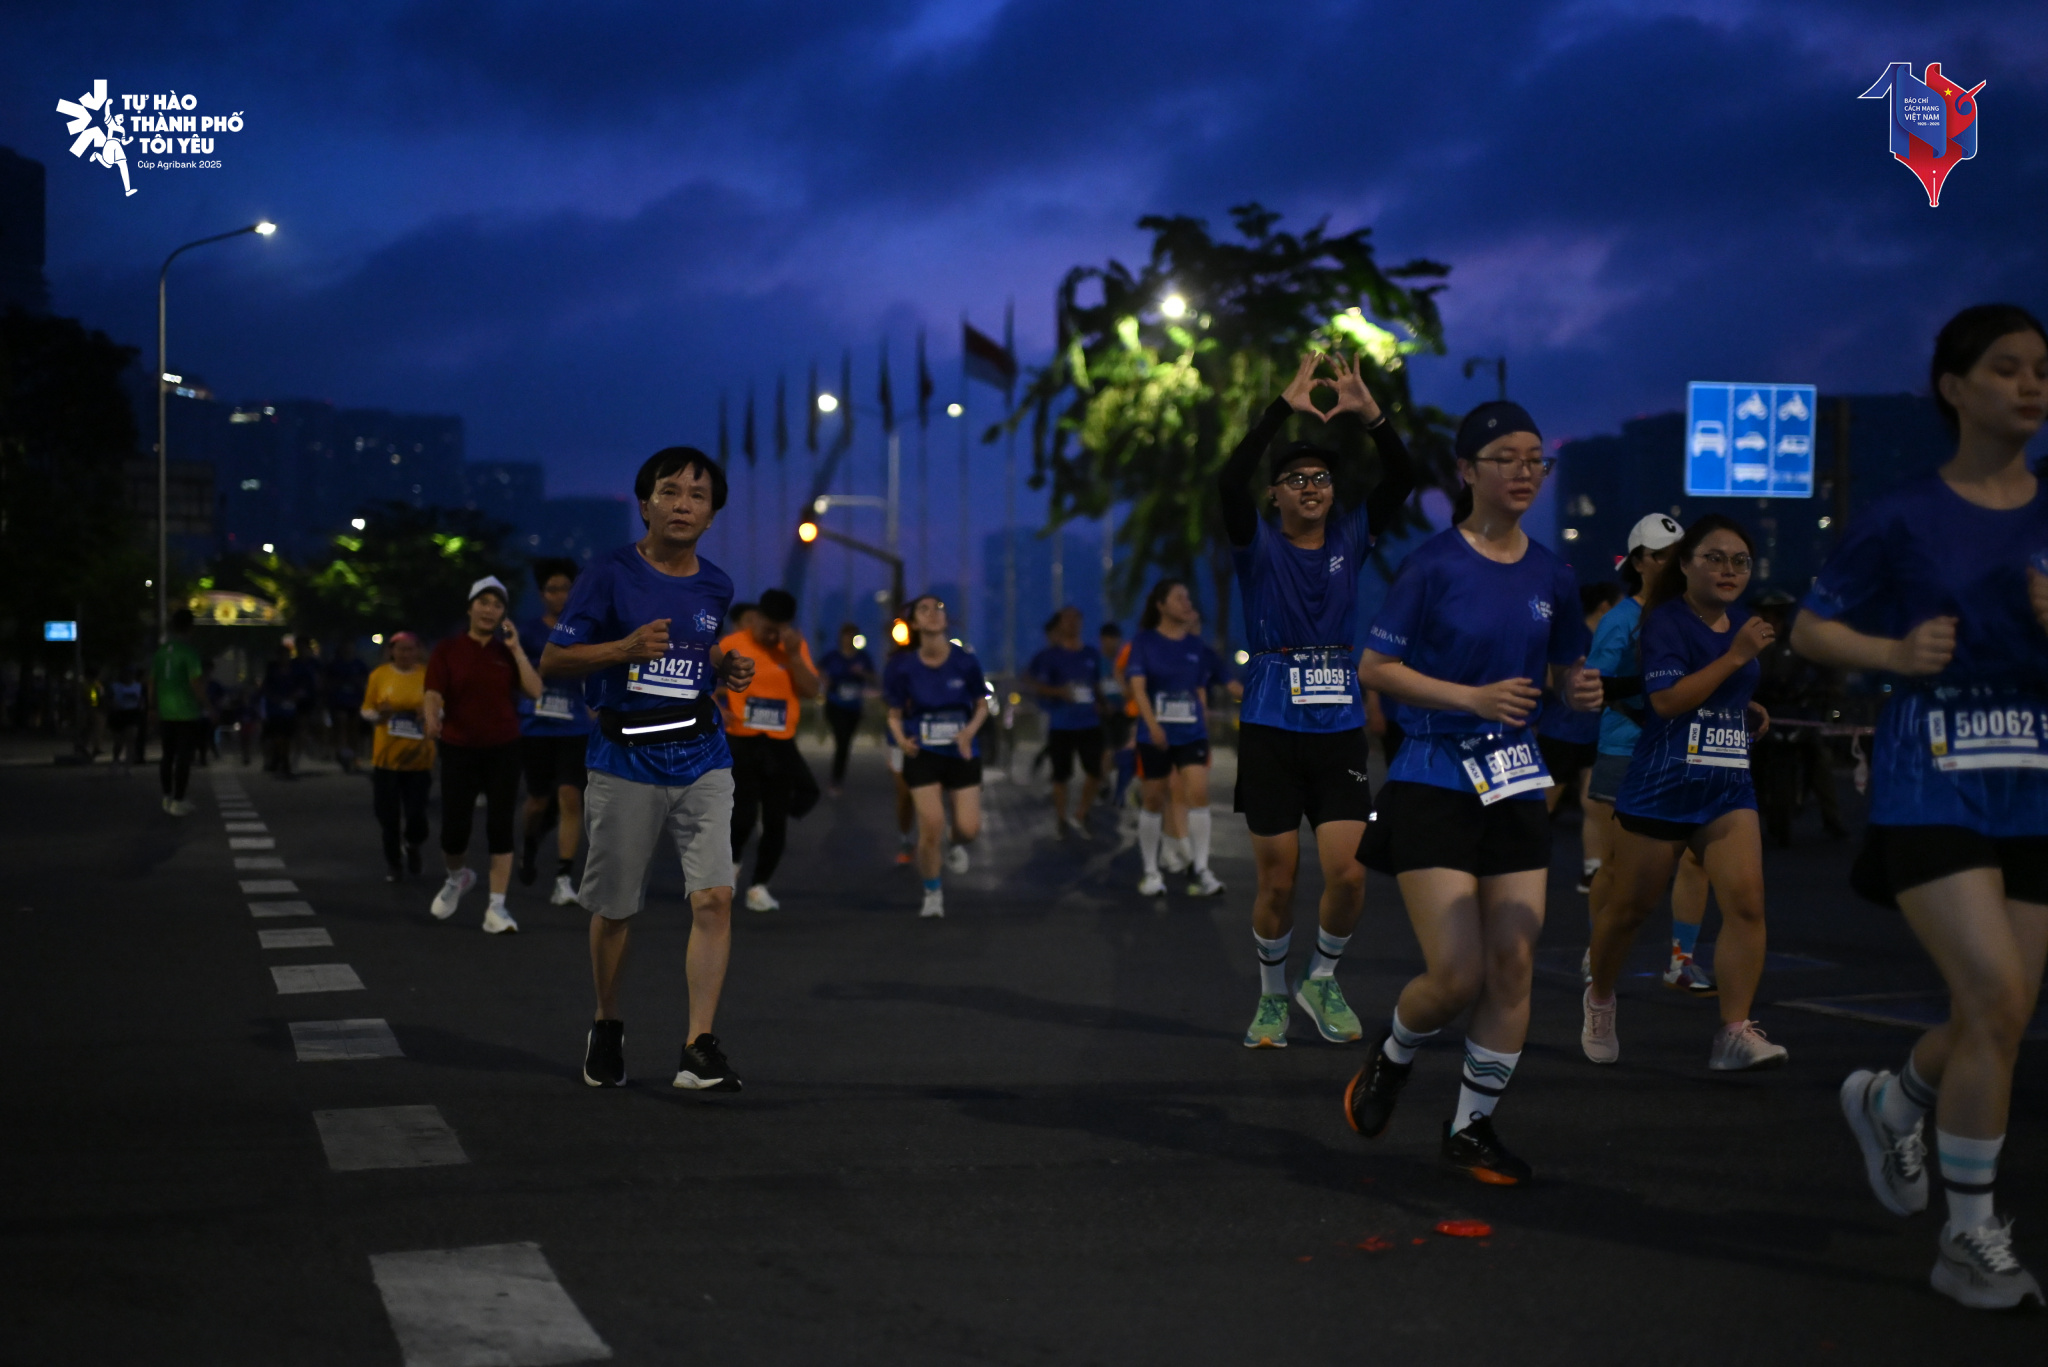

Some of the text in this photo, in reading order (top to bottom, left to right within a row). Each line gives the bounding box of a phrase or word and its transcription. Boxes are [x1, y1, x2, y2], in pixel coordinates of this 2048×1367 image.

[648, 656, 693, 678] 51427
[1305, 668, 1345, 685] 50059
[1954, 709, 2036, 738] 50062
[1705, 727, 1747, 748] 50599
[1484, 743, 1533, 775] 50267
